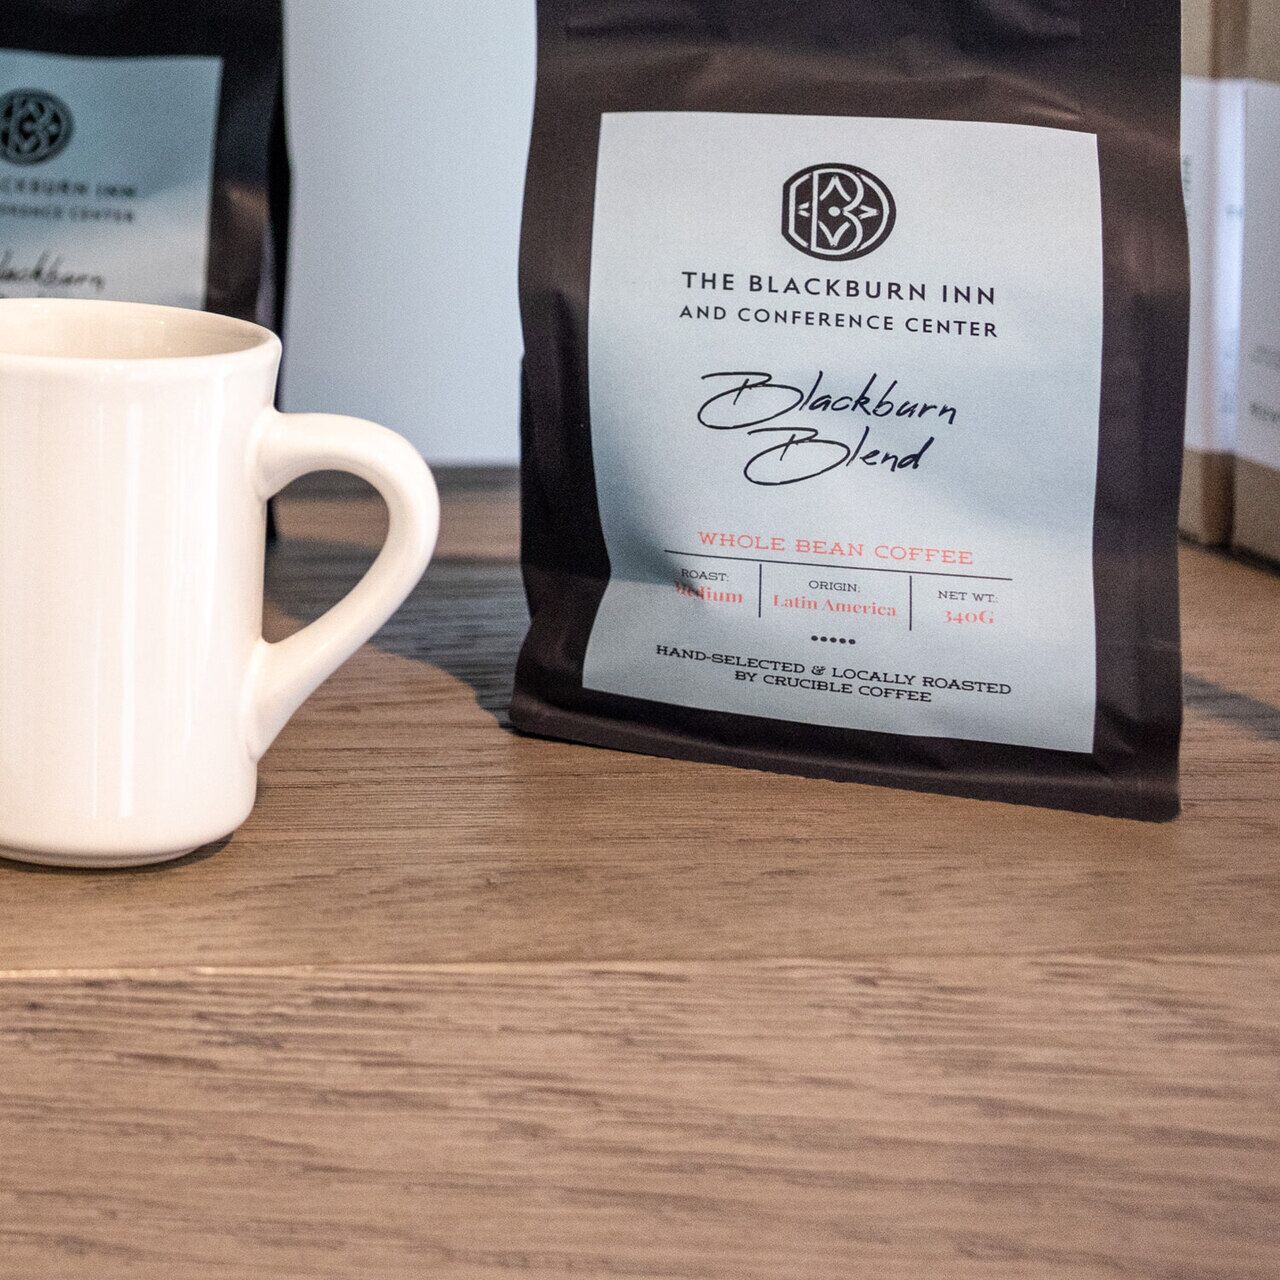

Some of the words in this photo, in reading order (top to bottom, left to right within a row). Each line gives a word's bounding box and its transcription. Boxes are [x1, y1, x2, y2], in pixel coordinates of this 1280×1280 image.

[682, 272, 734, 290] THE
[750, 275, 925, 300] BLACKBURN
[943, 285, 994, 304] INN
[680, 306, 726, 320] AND
[738, 308, 893, 330] CONFERENCE
[905, 318, 997, 337] CENTER
[697, 371, 958, 430] Blackburn
[743, 426, 934, 486] Blend
[699, 532, 785, 551] WHOLE
[796, 539, 863, 556] BEAN
[875, 545, 973, 565] COFFEE
[681, 569, 729, 582] ROAST:
[809, 580, 861, 592] ORIGIN:
[774, 595, 817, 609] Latin
[826, 600, 896, 616] America
[938, 591, 967, 600] NET
[947, 611, 993, 623] 340G
[656, 644, 805, 674] HAND-SELECTED
[811, 666, 825, 675] &
[832, 668, 916, 687] LOCALLY
[922, 676, 1012, 695] ROASTED
[735, 670, 757, 682] BY
[763, 675, 852, 694] CRUCIBLE
[859, 686, 931, 702] COFFEE
